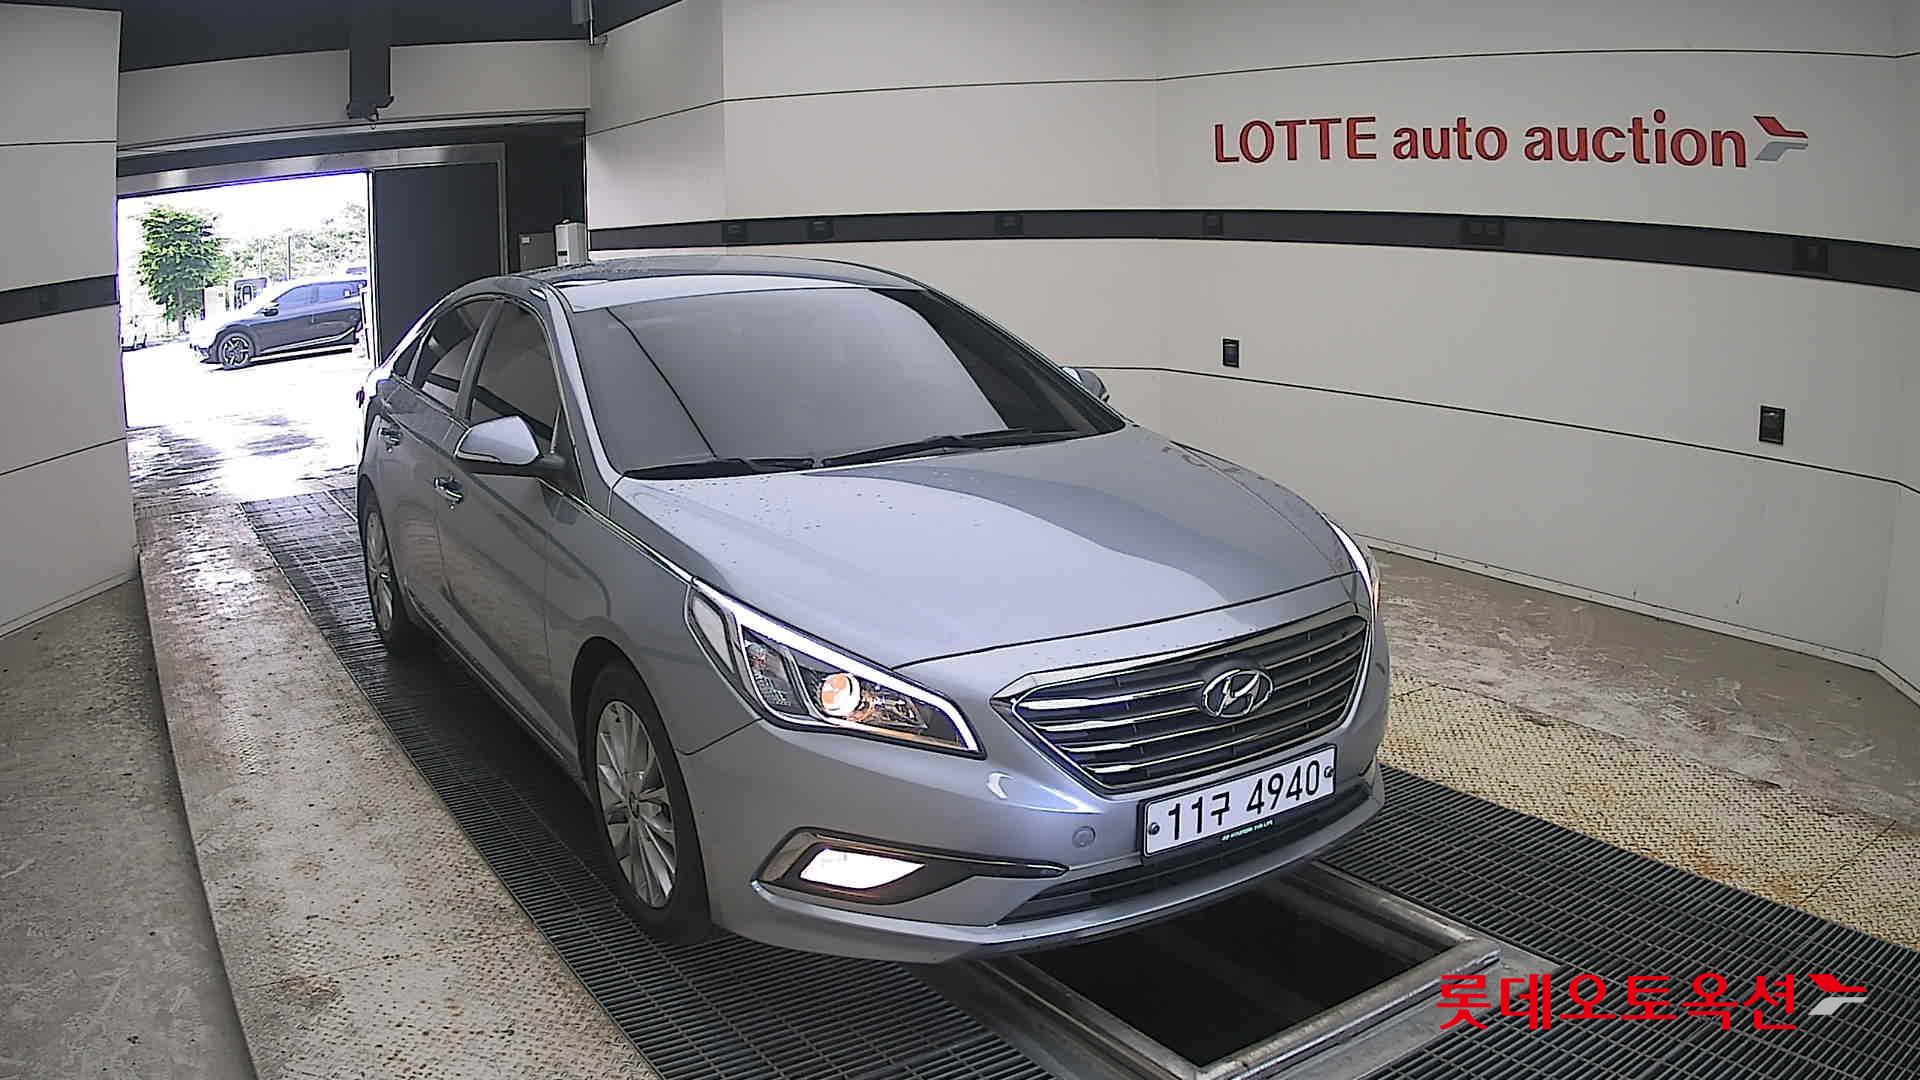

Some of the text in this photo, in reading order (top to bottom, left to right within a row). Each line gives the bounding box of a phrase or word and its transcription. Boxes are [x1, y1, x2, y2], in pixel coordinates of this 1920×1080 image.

[1214, 108, 1747, 168] LOTTE auto auction
[1168, 791, 1231, 841] 11구
[1246, 759, 1320, 814] 4940
